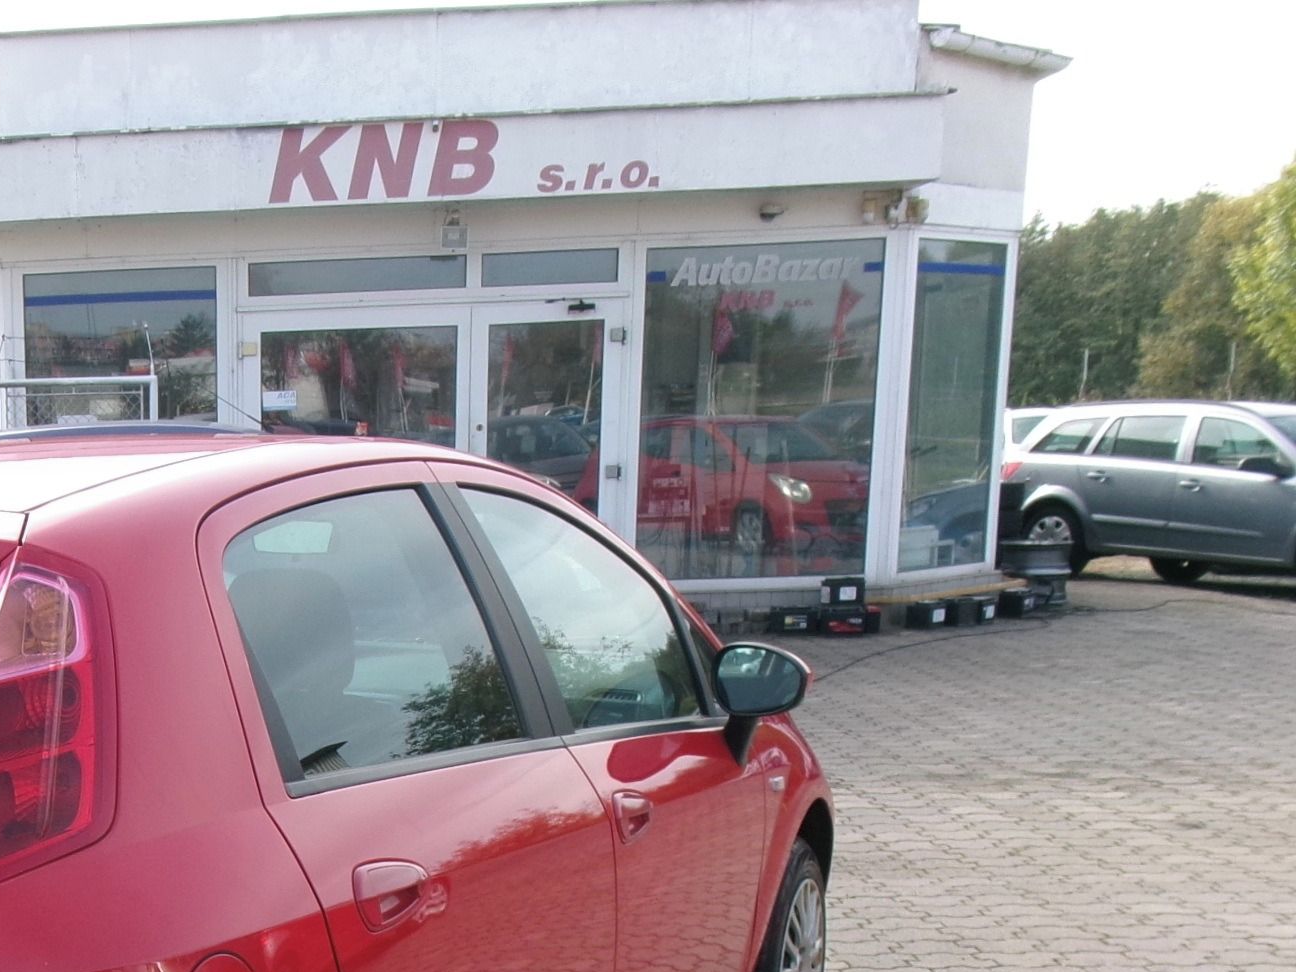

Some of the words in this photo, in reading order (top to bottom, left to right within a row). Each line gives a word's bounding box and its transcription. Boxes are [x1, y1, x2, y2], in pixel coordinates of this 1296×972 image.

[269, 119, 499, 204] KNB
[536, 160, 660, 193] s.r.o.
[670, 253, 859, 287] AutoBazar
